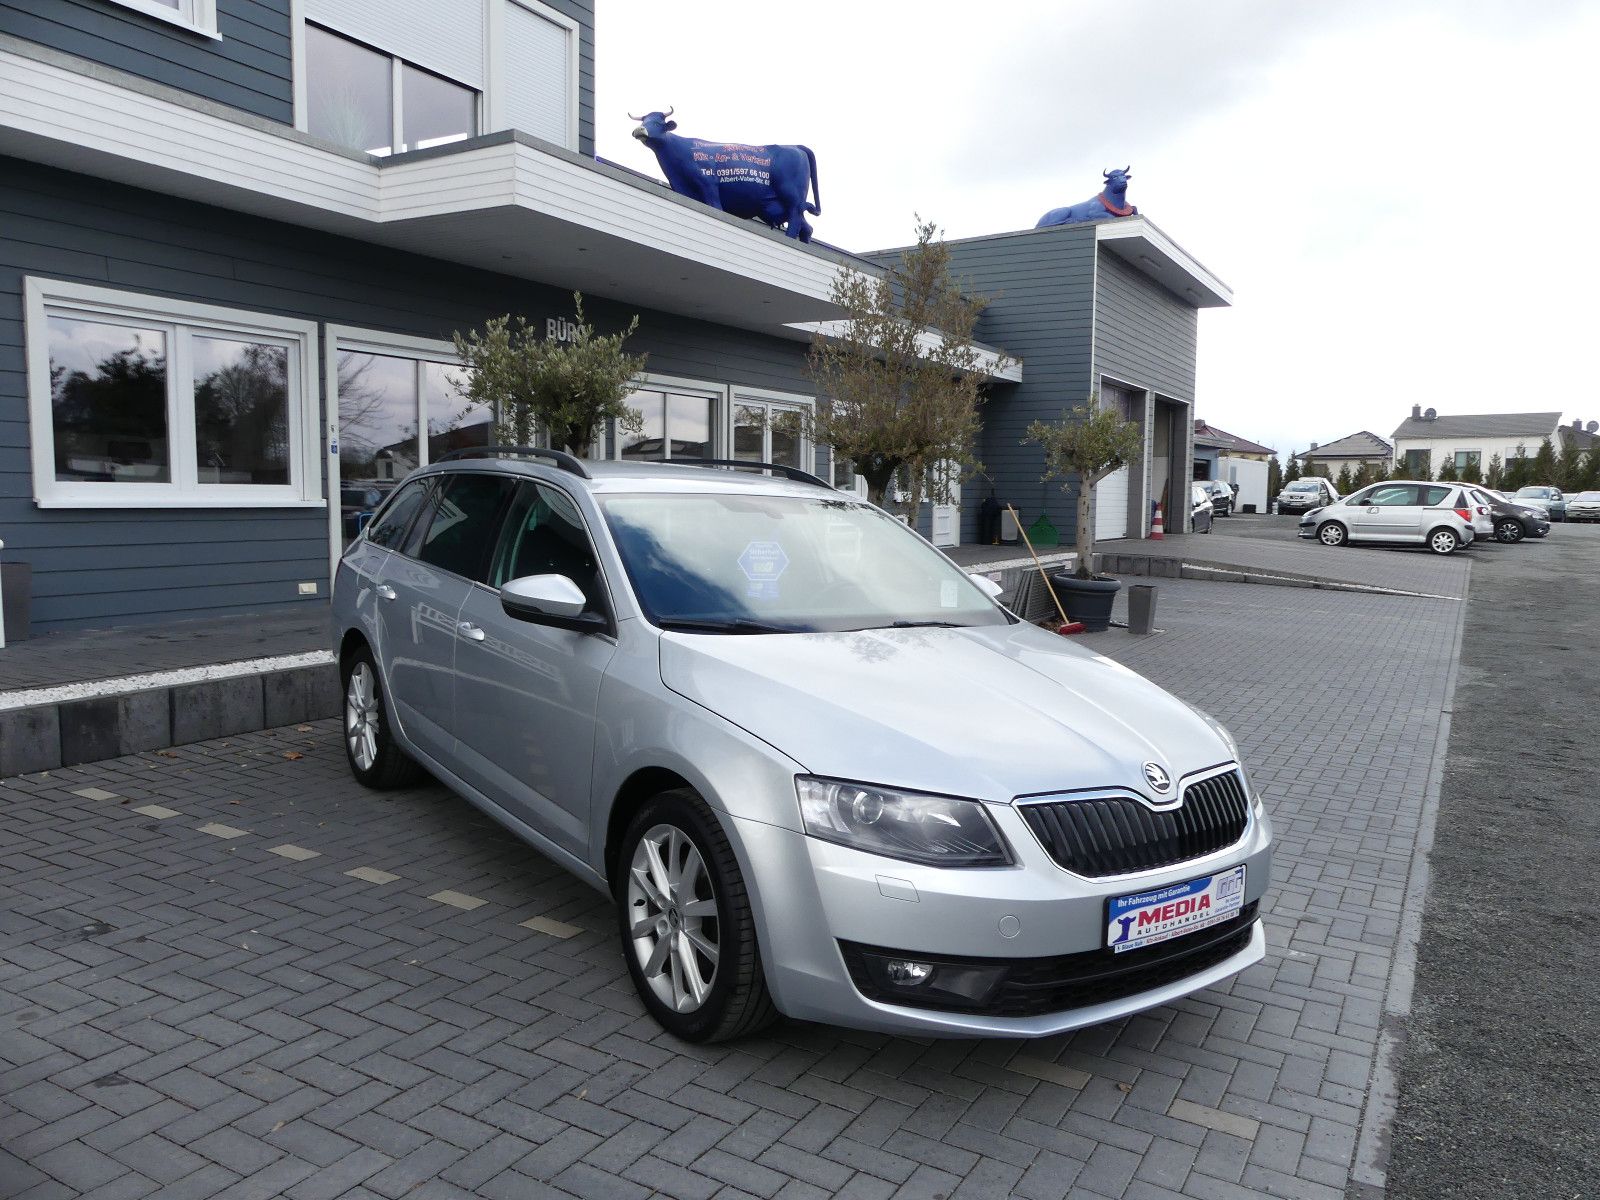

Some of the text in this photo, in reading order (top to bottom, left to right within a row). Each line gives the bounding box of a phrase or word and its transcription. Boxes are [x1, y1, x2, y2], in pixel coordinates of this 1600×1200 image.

[759, 171, 770, 179] 100
[1128, 895, 1157, 905] Fahrzeug
[1157, 892, 1168, 900] mit
[1168, 885, 1190, 896] Garantie
[1138, 894, 1210, 927] MEDIA
[1137, 911, 1209, 935] AUTOHANDEL
